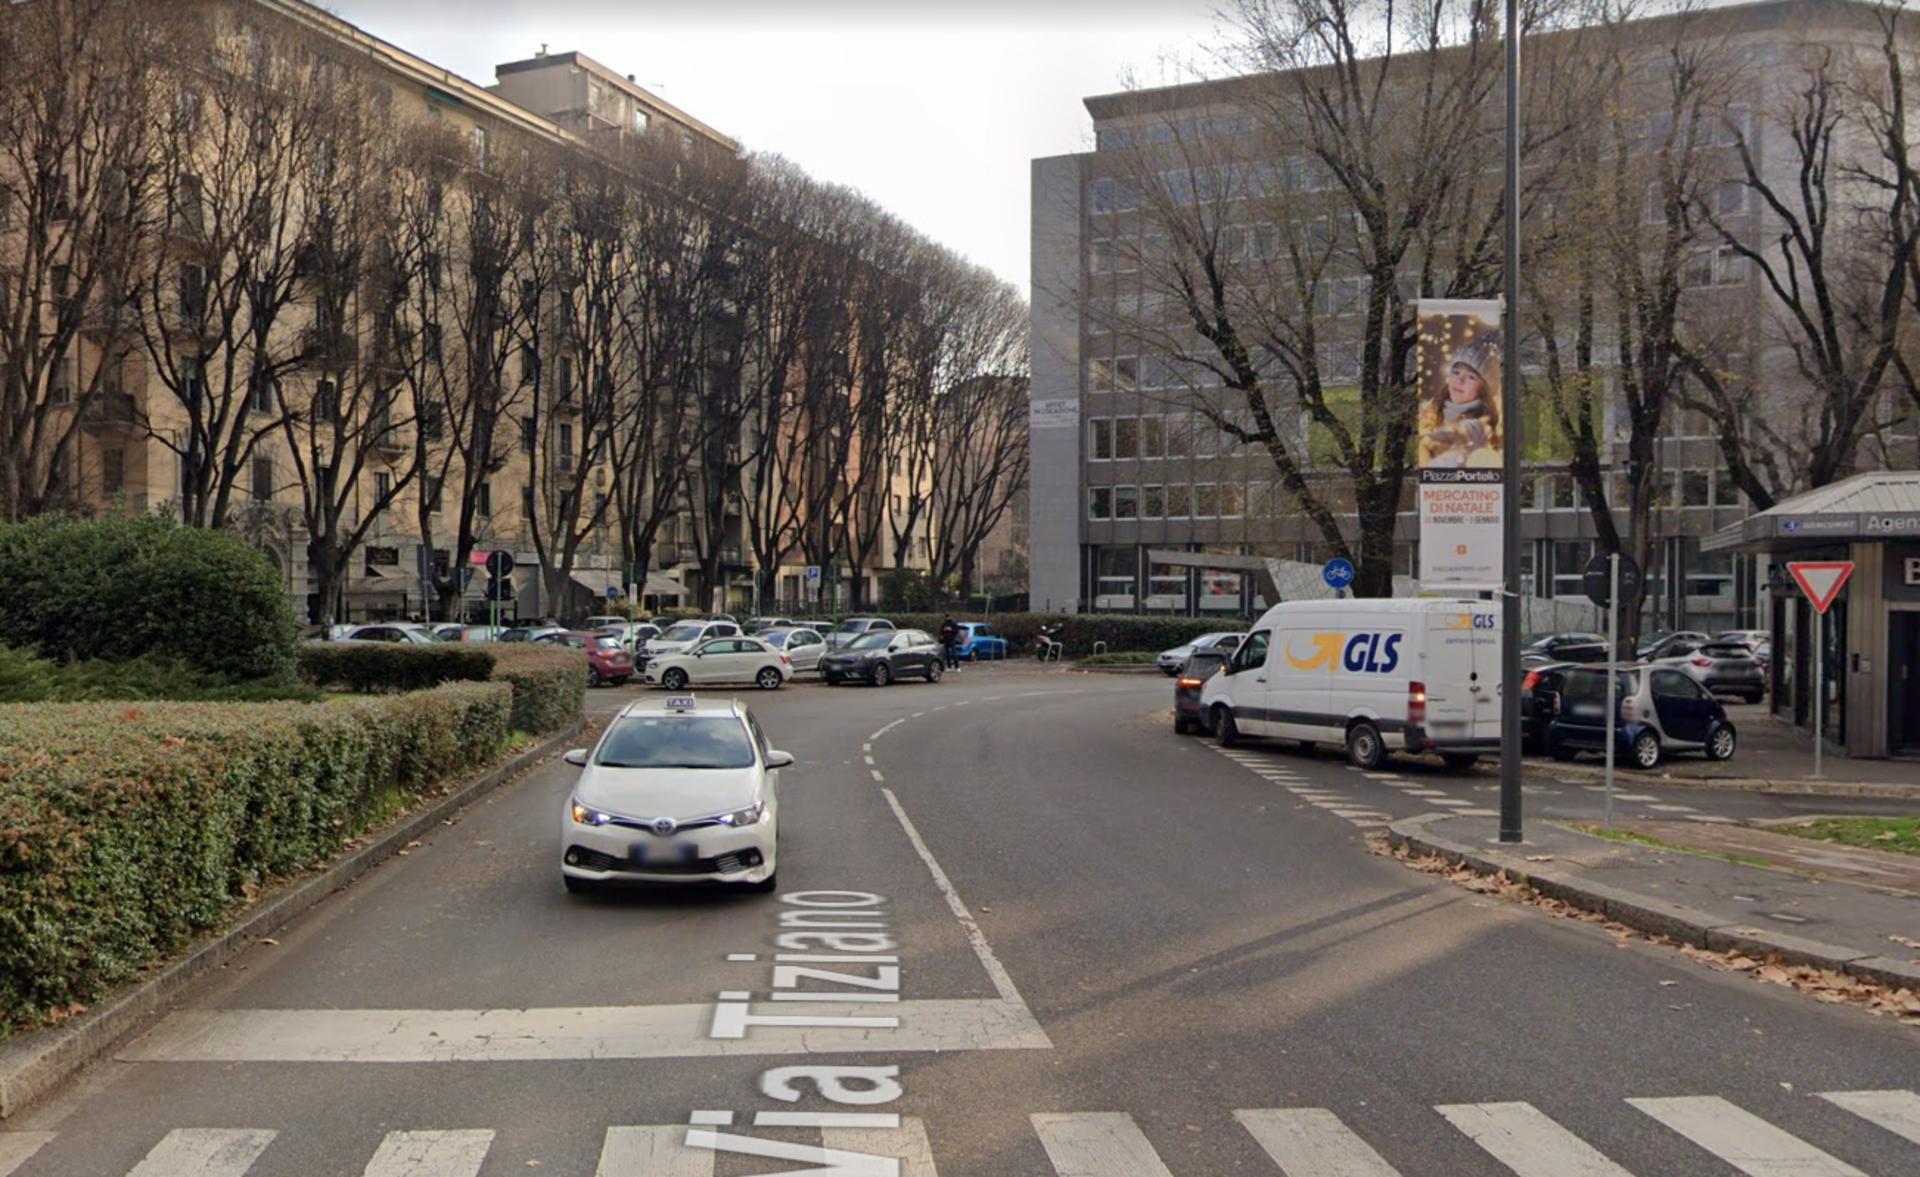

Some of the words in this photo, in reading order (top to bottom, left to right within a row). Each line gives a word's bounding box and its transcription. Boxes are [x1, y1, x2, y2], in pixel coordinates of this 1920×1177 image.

[1423, 470, 1500, 482] PiazzaPortello
[1423, 489, 1500, 501] MERCATINO
[1430, 503, 1443, 513] DI
[1445, 503, 1494, 513] NATALE
[1473, 613, 1495, 629] GLS
[1343, 632, 1403, 673] GLS
[667, 698, 693, 706] TAXI
